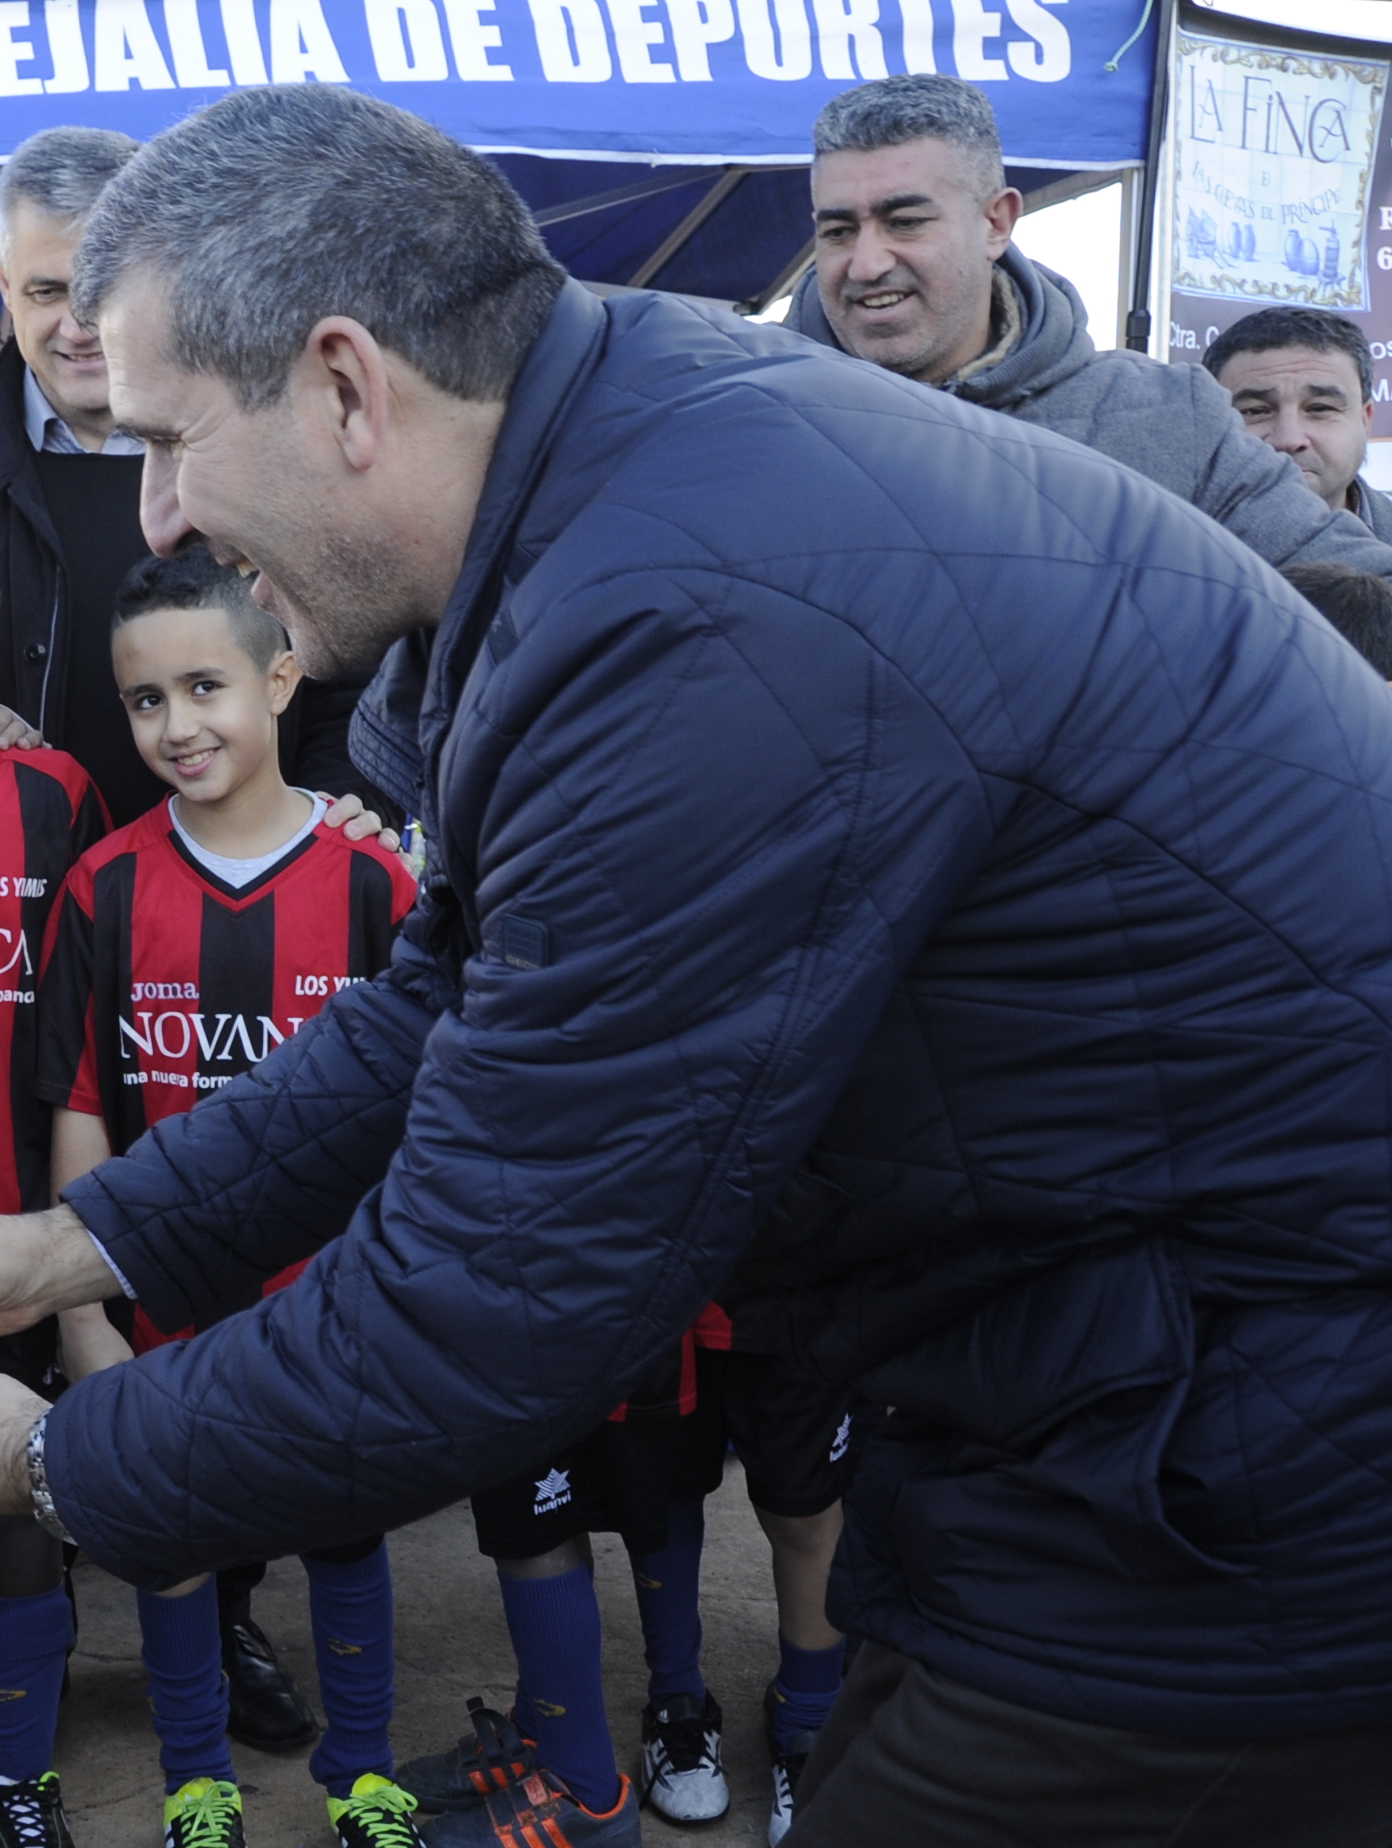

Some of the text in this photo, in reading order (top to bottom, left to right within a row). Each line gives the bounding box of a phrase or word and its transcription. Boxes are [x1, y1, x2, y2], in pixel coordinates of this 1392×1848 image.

[365, 0, 514, 82] DE
[532, 0, 1072, 83] DEPORTES
[1189, 65, 1224, 143] LA
[295, 974, 328, 996] LOS
[119, 1011, 304, 1063] NOVAN
